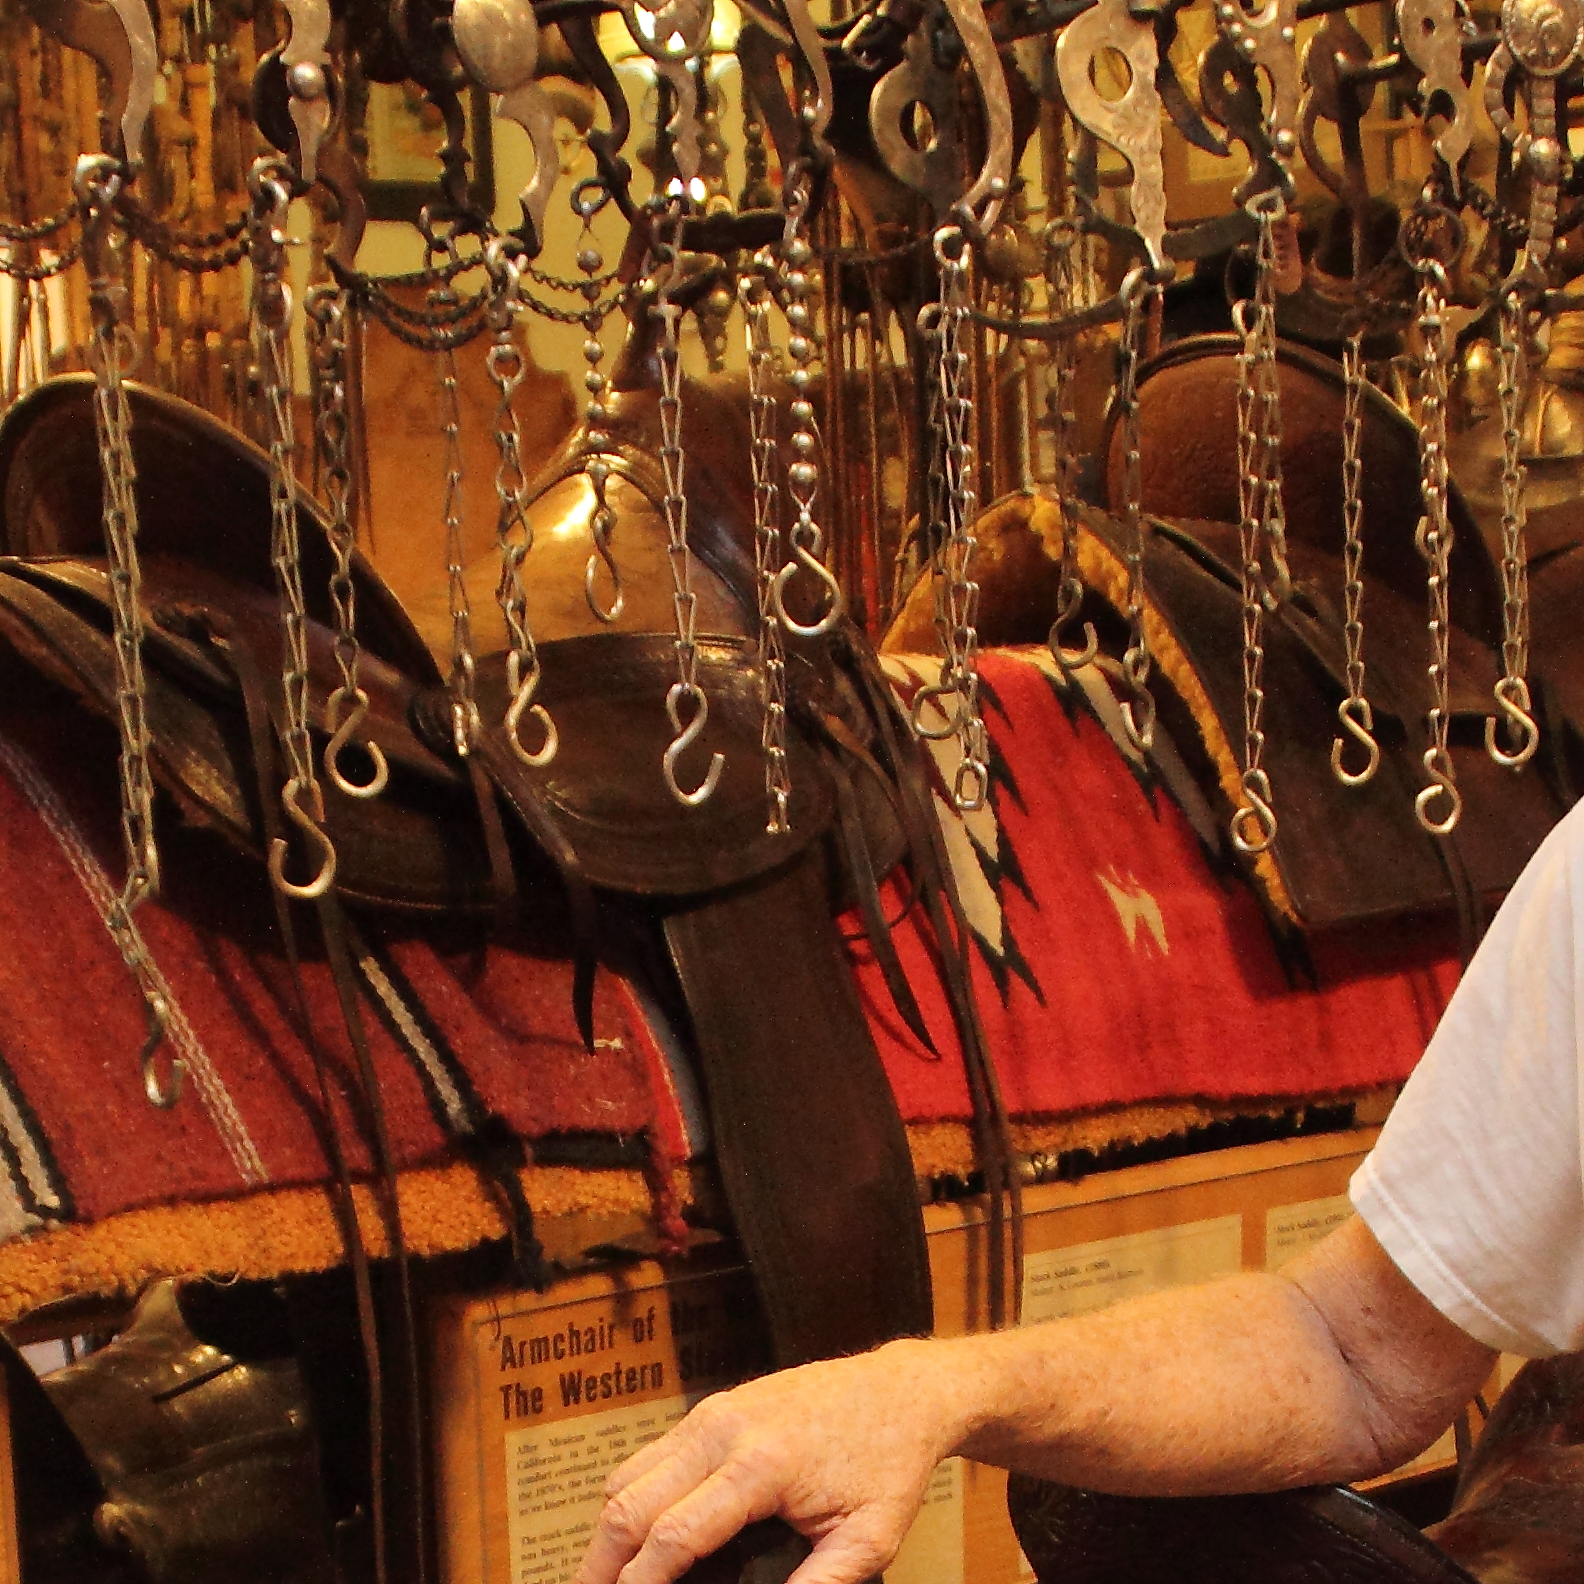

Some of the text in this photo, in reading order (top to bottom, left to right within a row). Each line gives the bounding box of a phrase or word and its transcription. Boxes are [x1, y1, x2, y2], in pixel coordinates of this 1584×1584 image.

[499, 1316, 615, 1373] Armchair
[631, 1305, 656, 1344] of
[500, 1382, 544, 1421] The
[559, 1358, 665, 1409] Western
